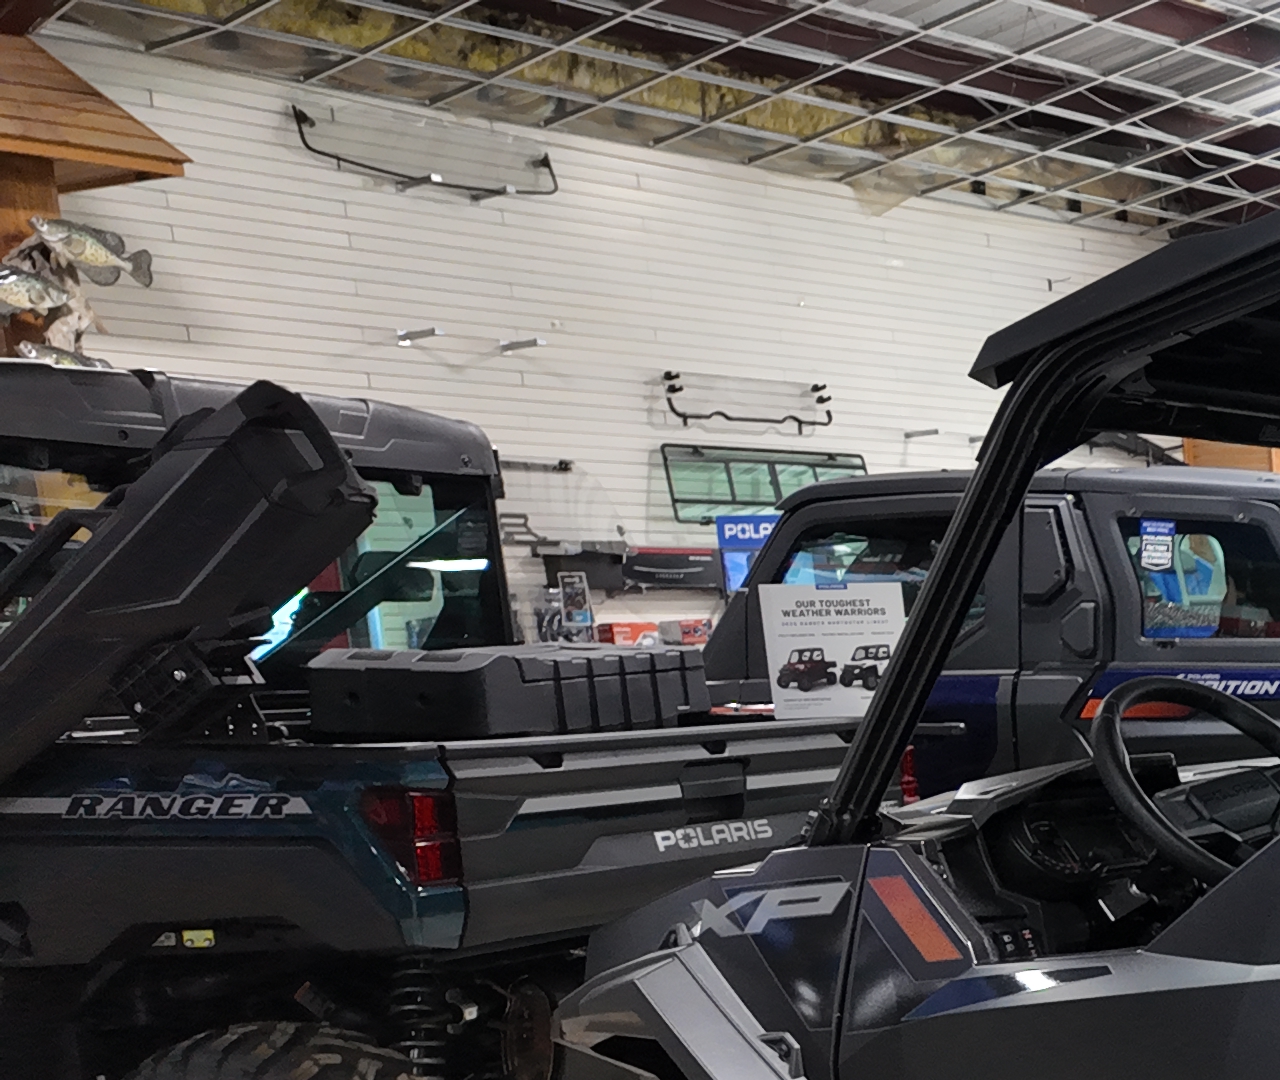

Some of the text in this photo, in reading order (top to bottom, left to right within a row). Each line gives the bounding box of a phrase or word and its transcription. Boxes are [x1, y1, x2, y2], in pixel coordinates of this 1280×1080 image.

[724, 522, 774, 540] POLA
[781, 607, 887, 618] WEATHER WARRIORS
[795, 598, 871, 608] OUR TOUGHEST
[61, 793, 291, 819] RANGER
[653, 818, 773, 852] POLARIS
[690, 881, 853, 938] XP
